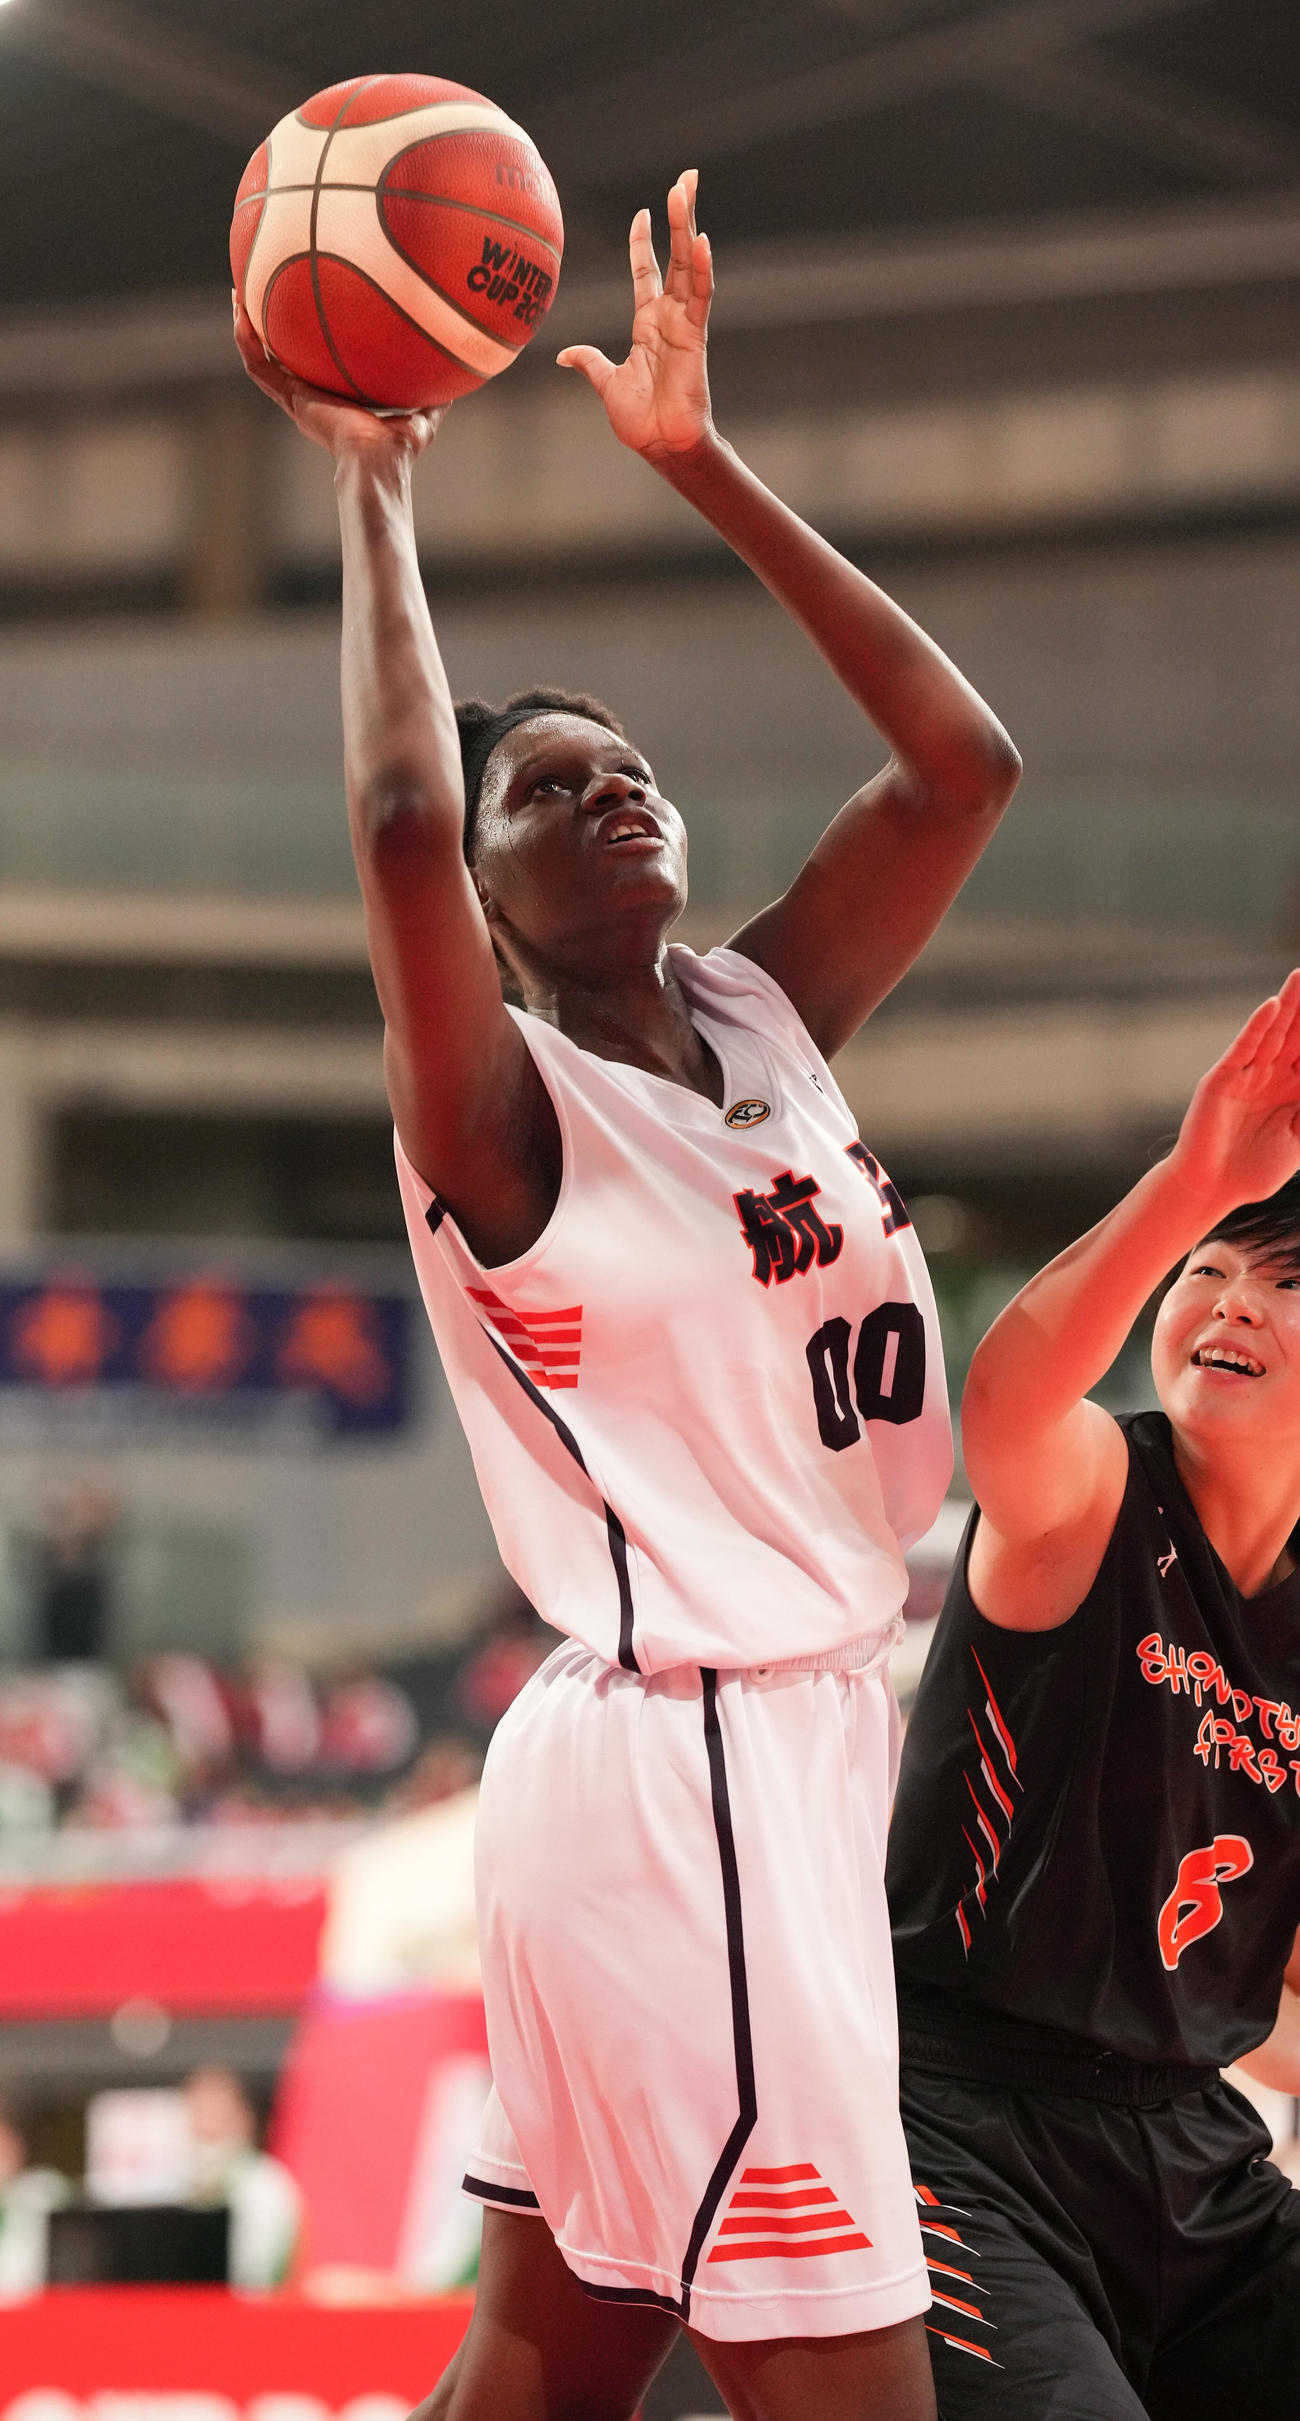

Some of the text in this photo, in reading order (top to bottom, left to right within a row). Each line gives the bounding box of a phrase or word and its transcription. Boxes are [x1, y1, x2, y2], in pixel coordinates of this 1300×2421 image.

[467, 265, 520, 306] CUP
[806, 1302, 926, 1452] 00
[1157, 1834, 1254, 1971] 6
